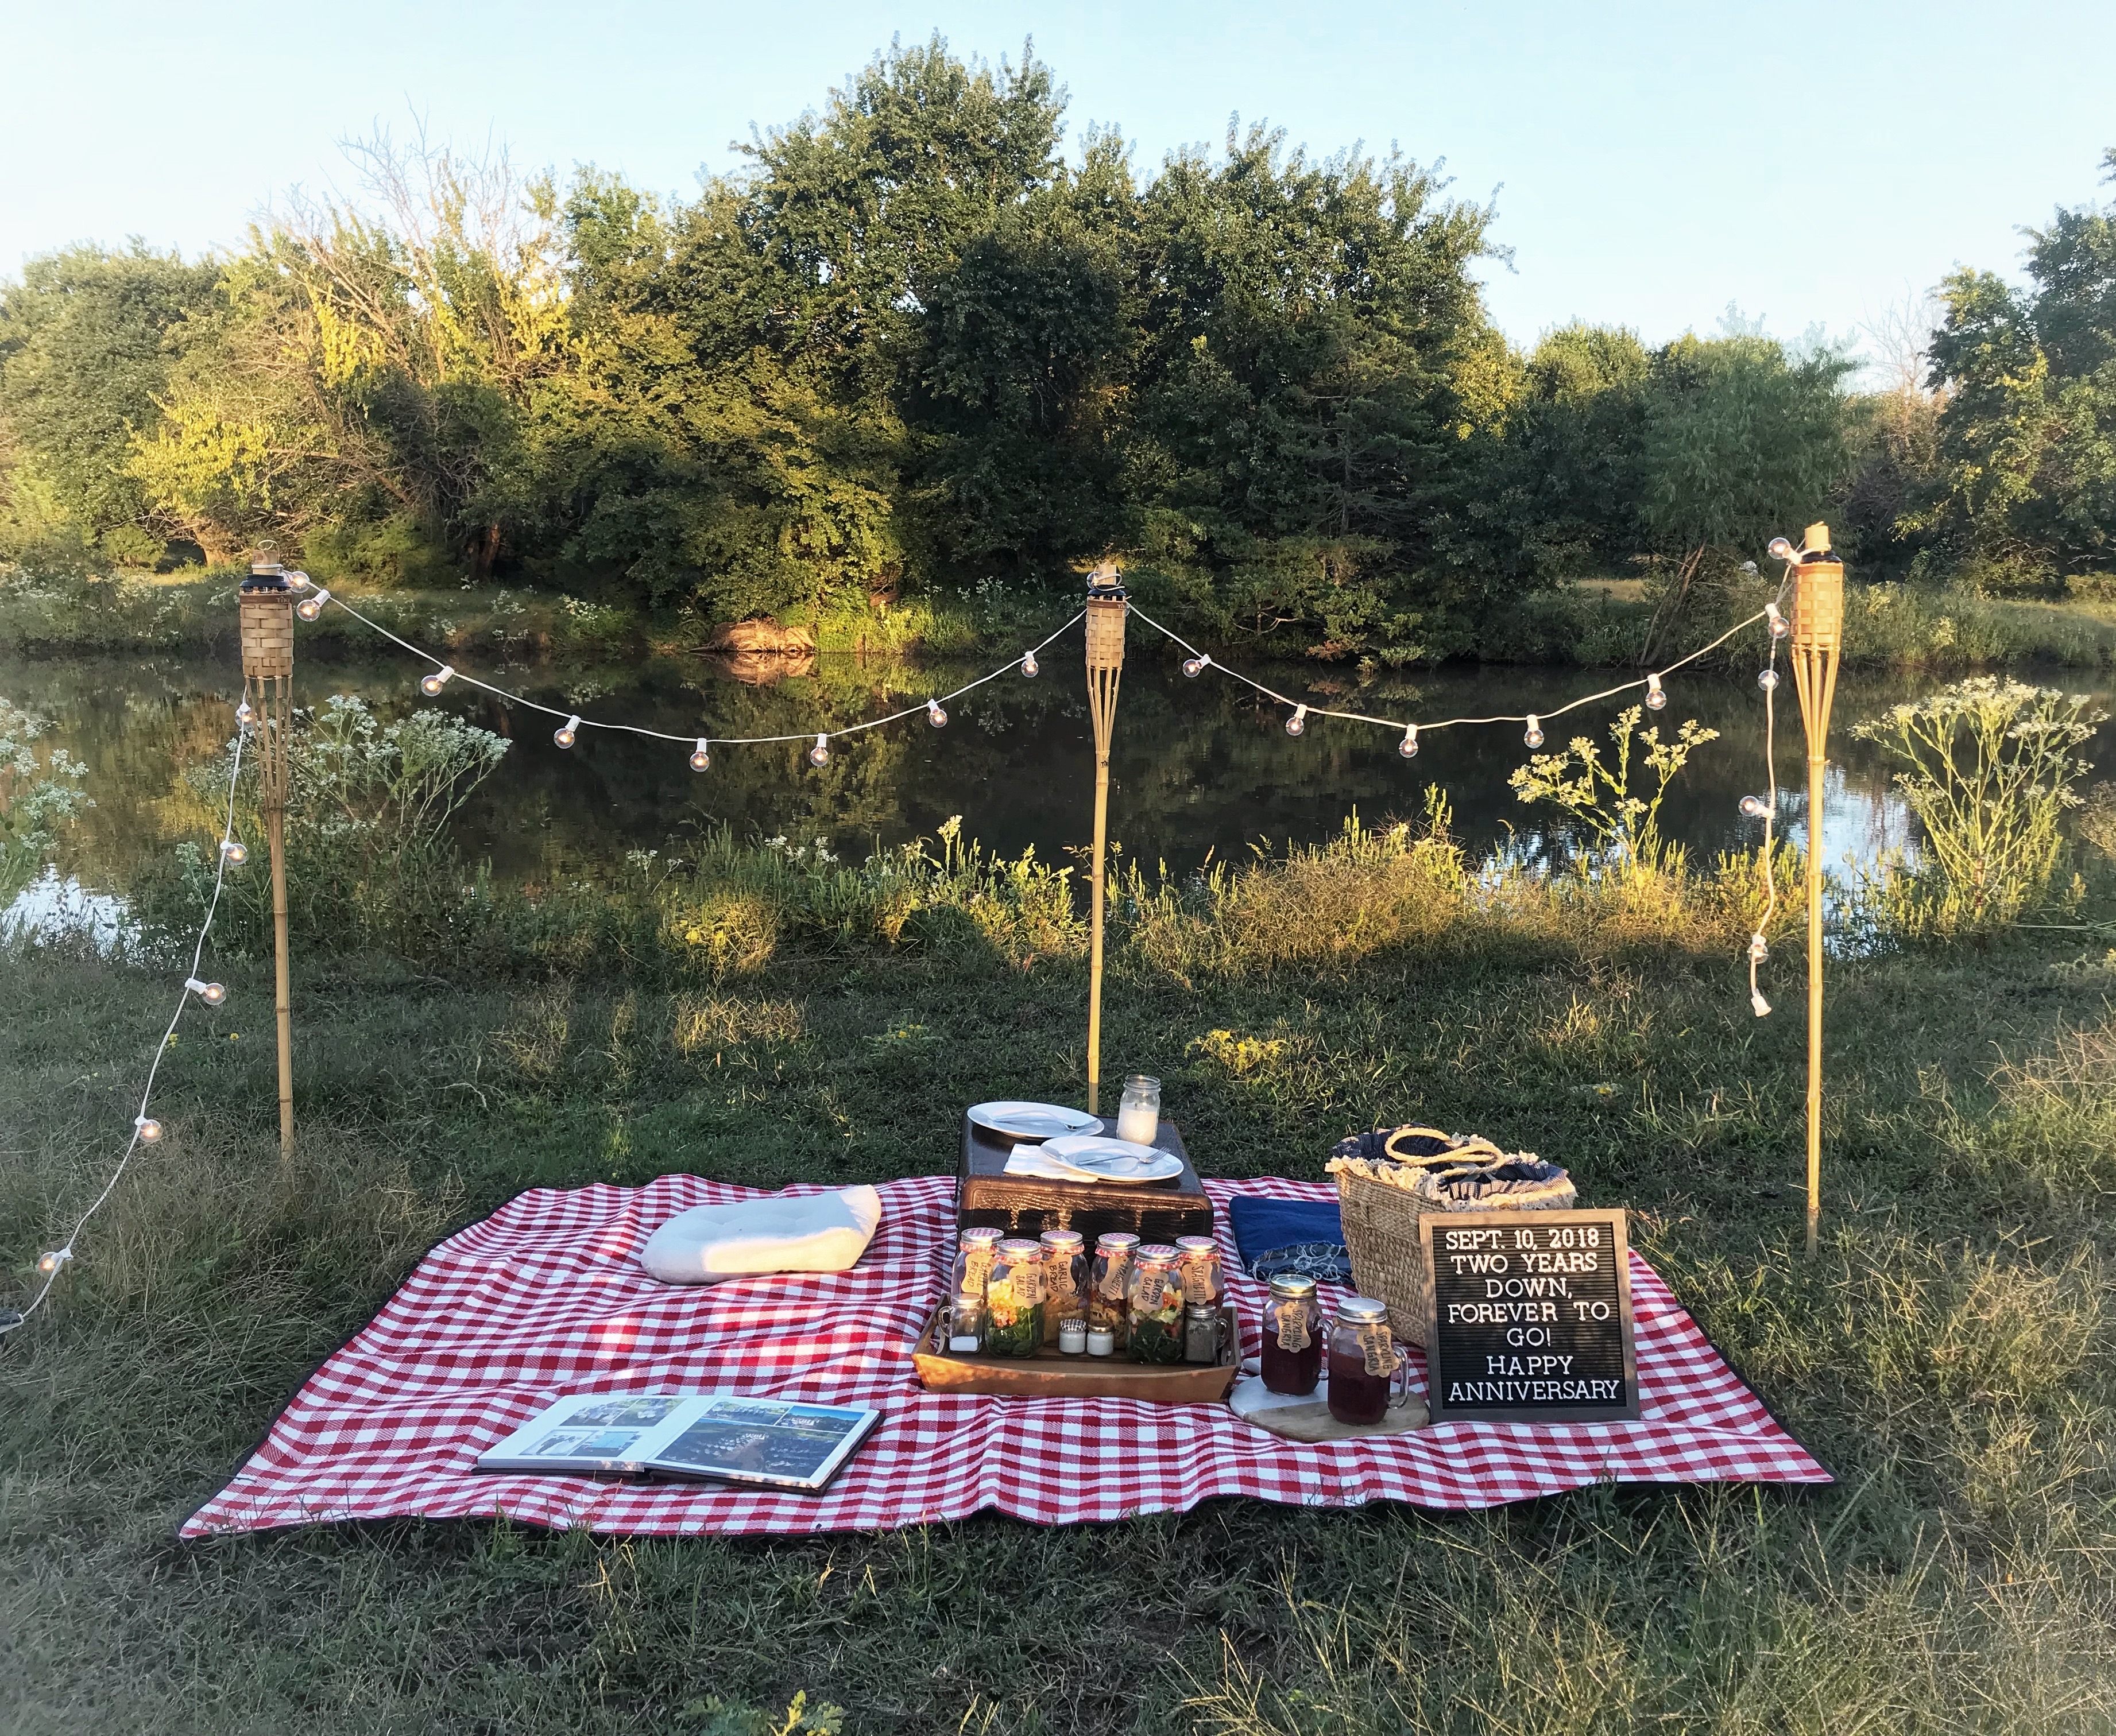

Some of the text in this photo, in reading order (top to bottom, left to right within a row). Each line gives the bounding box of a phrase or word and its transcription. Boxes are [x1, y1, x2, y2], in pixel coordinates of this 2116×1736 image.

[1445, 1227, 1599, 1251] SEPT. 10, 2018
[967, 1260, 978, 1287] BREAD
[977, 1262, 992, 1289] GARLIC
[1058, 1261, 1068, 1289] GARLIC
[1450, 1252, 1598, 1275] TWO YEARS
[1016, 1275, 1025, 1297] SALAD
[1026, 1273, 1037, 1299] GARDEN
[1049, 1265, 1058, 1292] BREAD
[1108, 1264, 1128, 1296] SPAGHETTI
[1141, 1277, 1152, 1301] SALAD
[1149, 1278, 1164, 1305] GARDEN
[1192, 1265, 1206, 1299] SPAGHETTI
[1485, 1277, 1572, 1299] DOWN,
[1447, 1301, 1610, 1324] FOREVER TO
[1281, 1313, 1291, 1346] SANGRIA
[1292, 1308, 1303, 1348] SPARKLING
[1506, 1327, 1551, 1347] GO!
[1363, 1335, 1379, 1371] SANGRIA
[1376, 1331, 1393, 1370] SPARKLING
[1486, 1355, 1573, 1376] HAPPY
[1448, 1380, 1620, 1402] ANNIVERSARY
